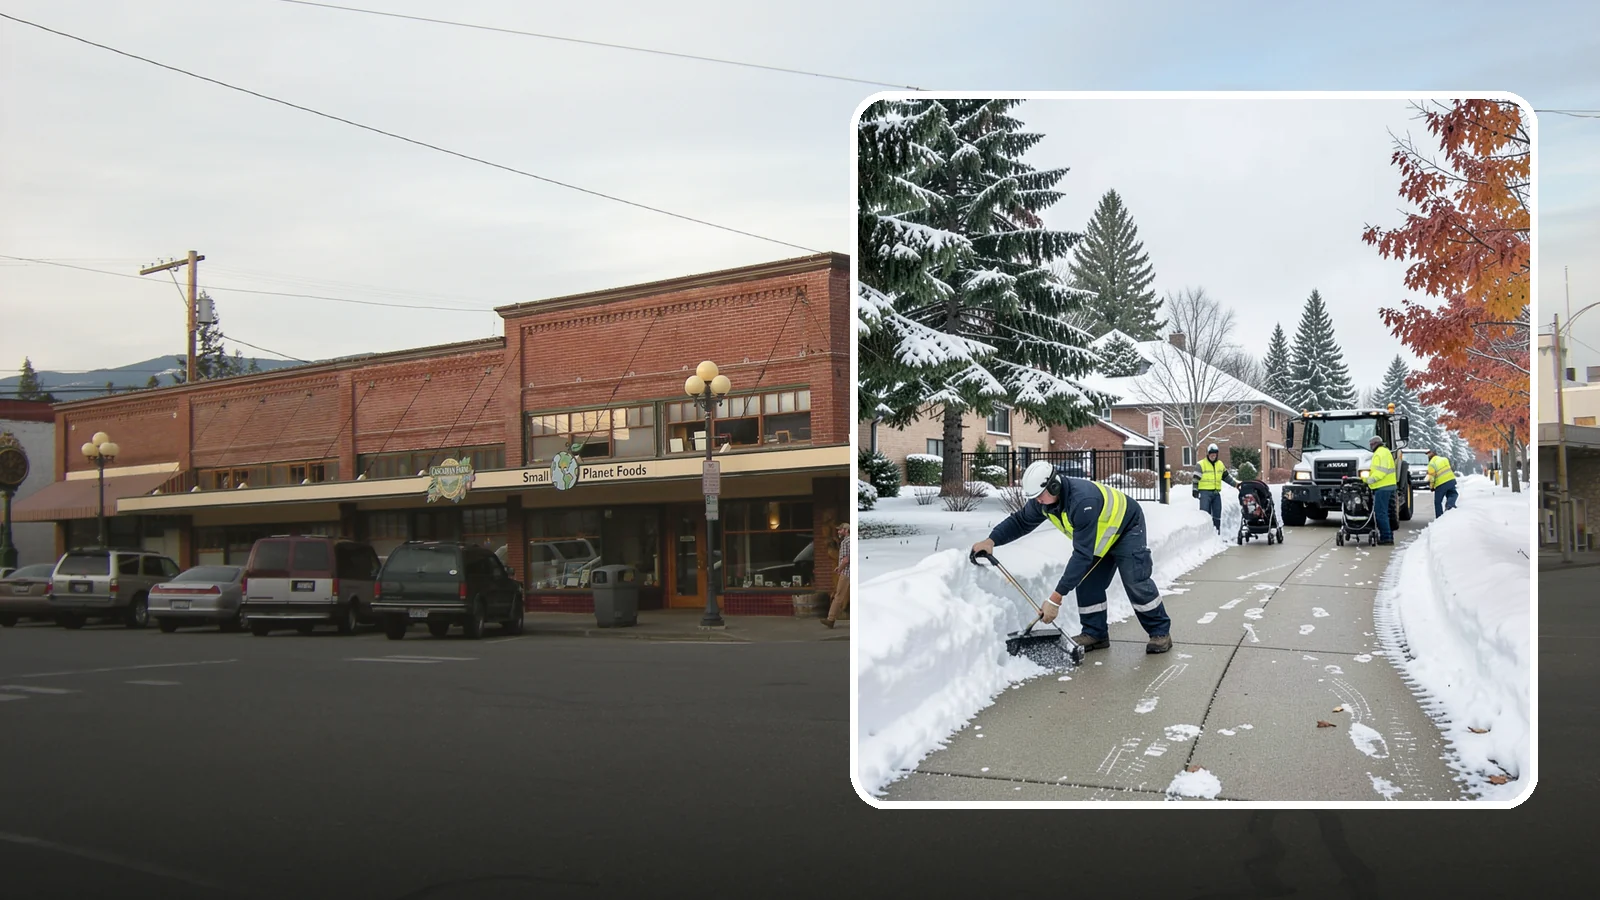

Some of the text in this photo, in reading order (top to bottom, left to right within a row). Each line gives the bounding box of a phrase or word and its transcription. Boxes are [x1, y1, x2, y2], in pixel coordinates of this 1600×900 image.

[523, 464, 647, 483] Small Planet Foods
